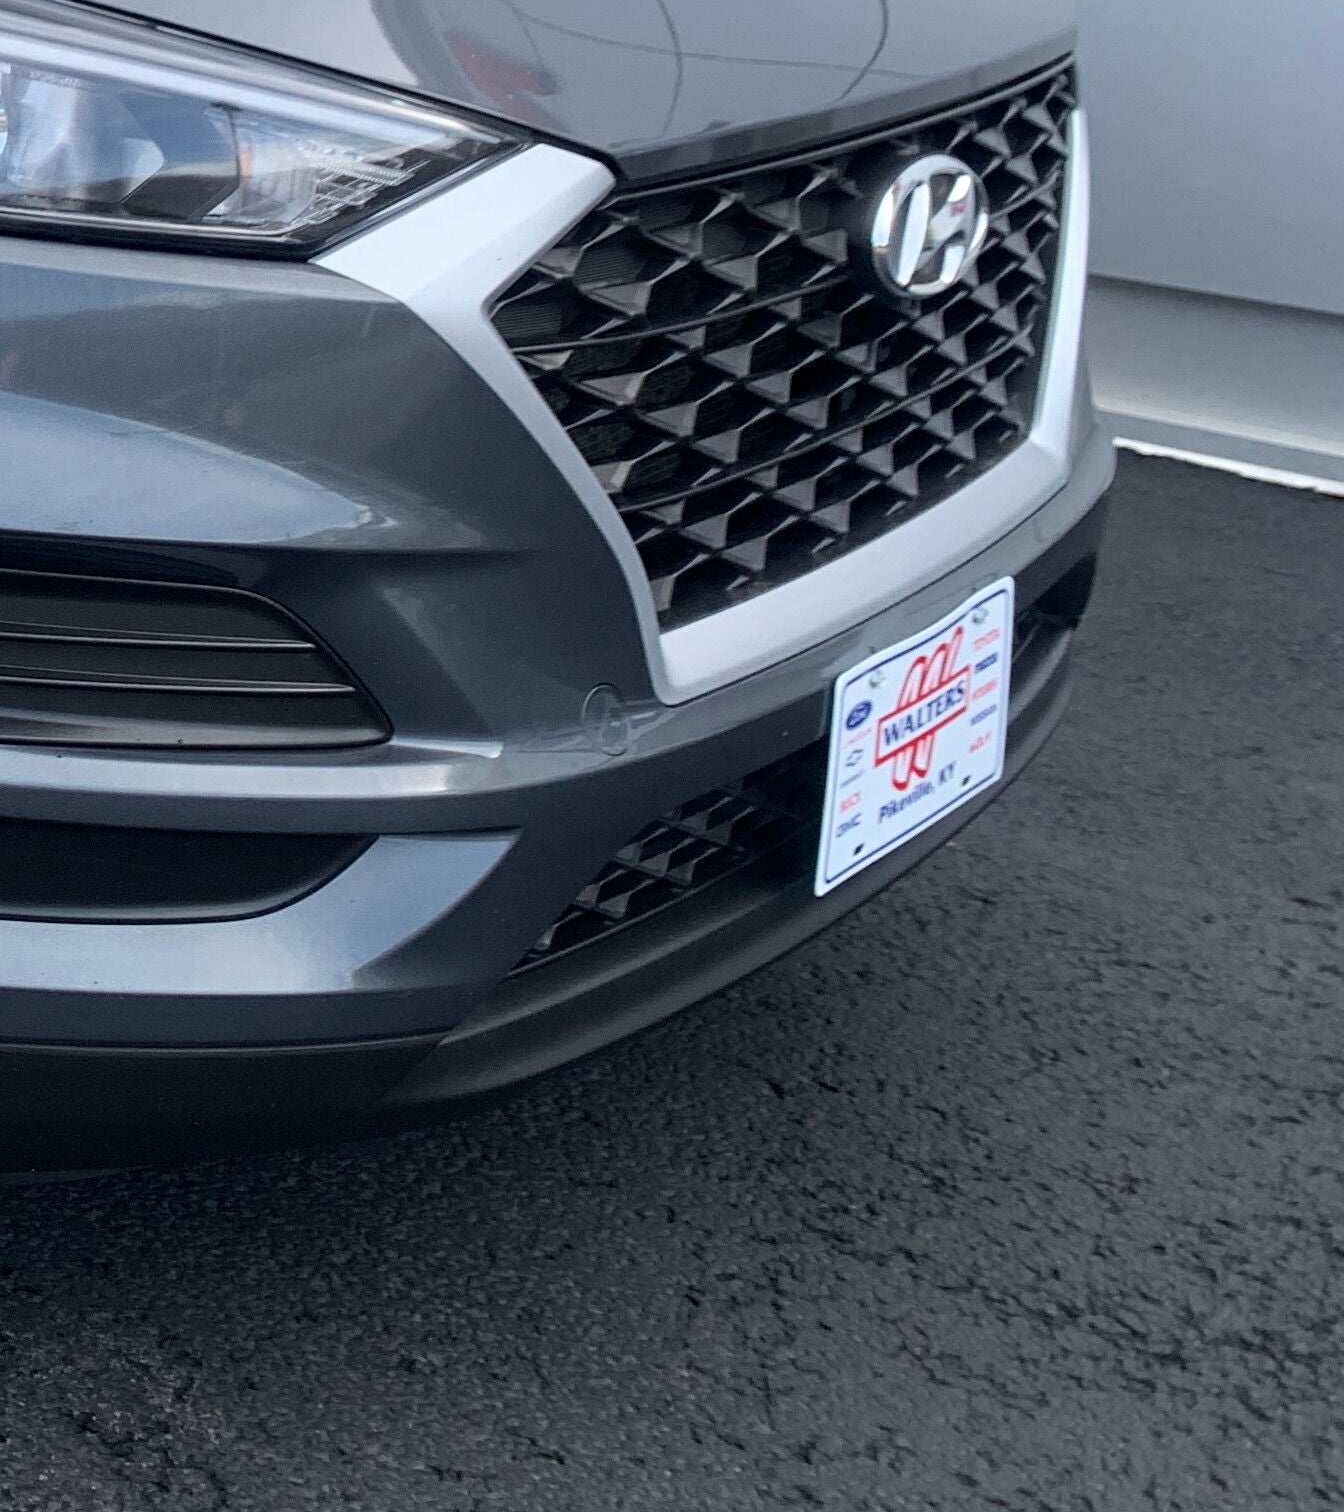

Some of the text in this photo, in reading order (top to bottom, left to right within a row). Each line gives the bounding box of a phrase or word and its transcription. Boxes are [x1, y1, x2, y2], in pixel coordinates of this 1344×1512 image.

[883, 680, 966, 746] WALTERS
[878, 781, 935, 824] Pikeville,
[938, 760, 957, 786] KY
